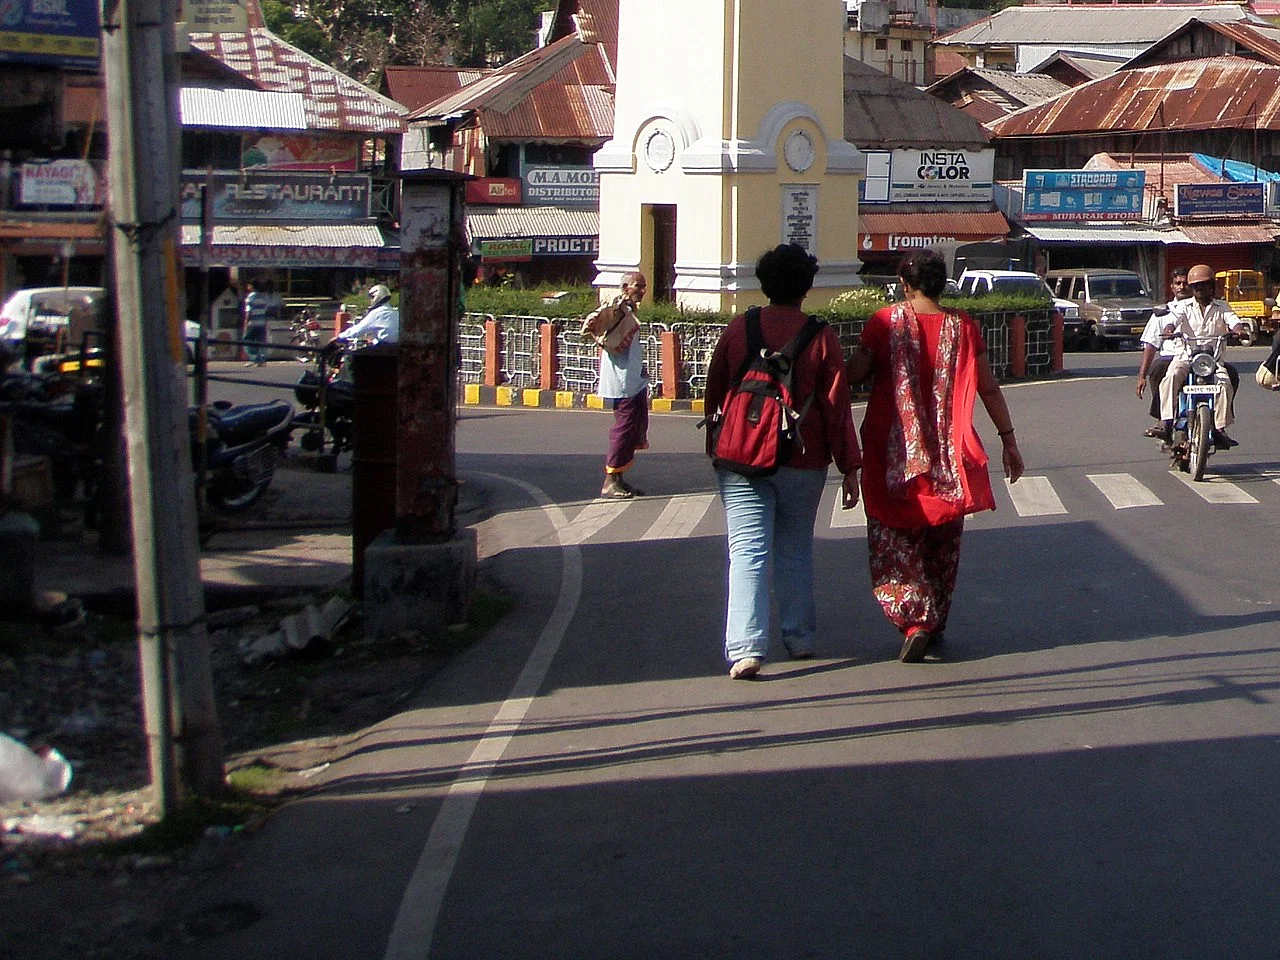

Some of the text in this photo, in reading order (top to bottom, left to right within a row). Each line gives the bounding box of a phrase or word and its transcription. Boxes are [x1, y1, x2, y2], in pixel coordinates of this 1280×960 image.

[920, 152, 967, 166] INSTA
[917, 166, 970, 180] COLOR
[1070, 173, 1118, 184] STANDARD
[489, 184, 516, 196] Airtel
[1052, 212, 1104, 220] MUBARAK
